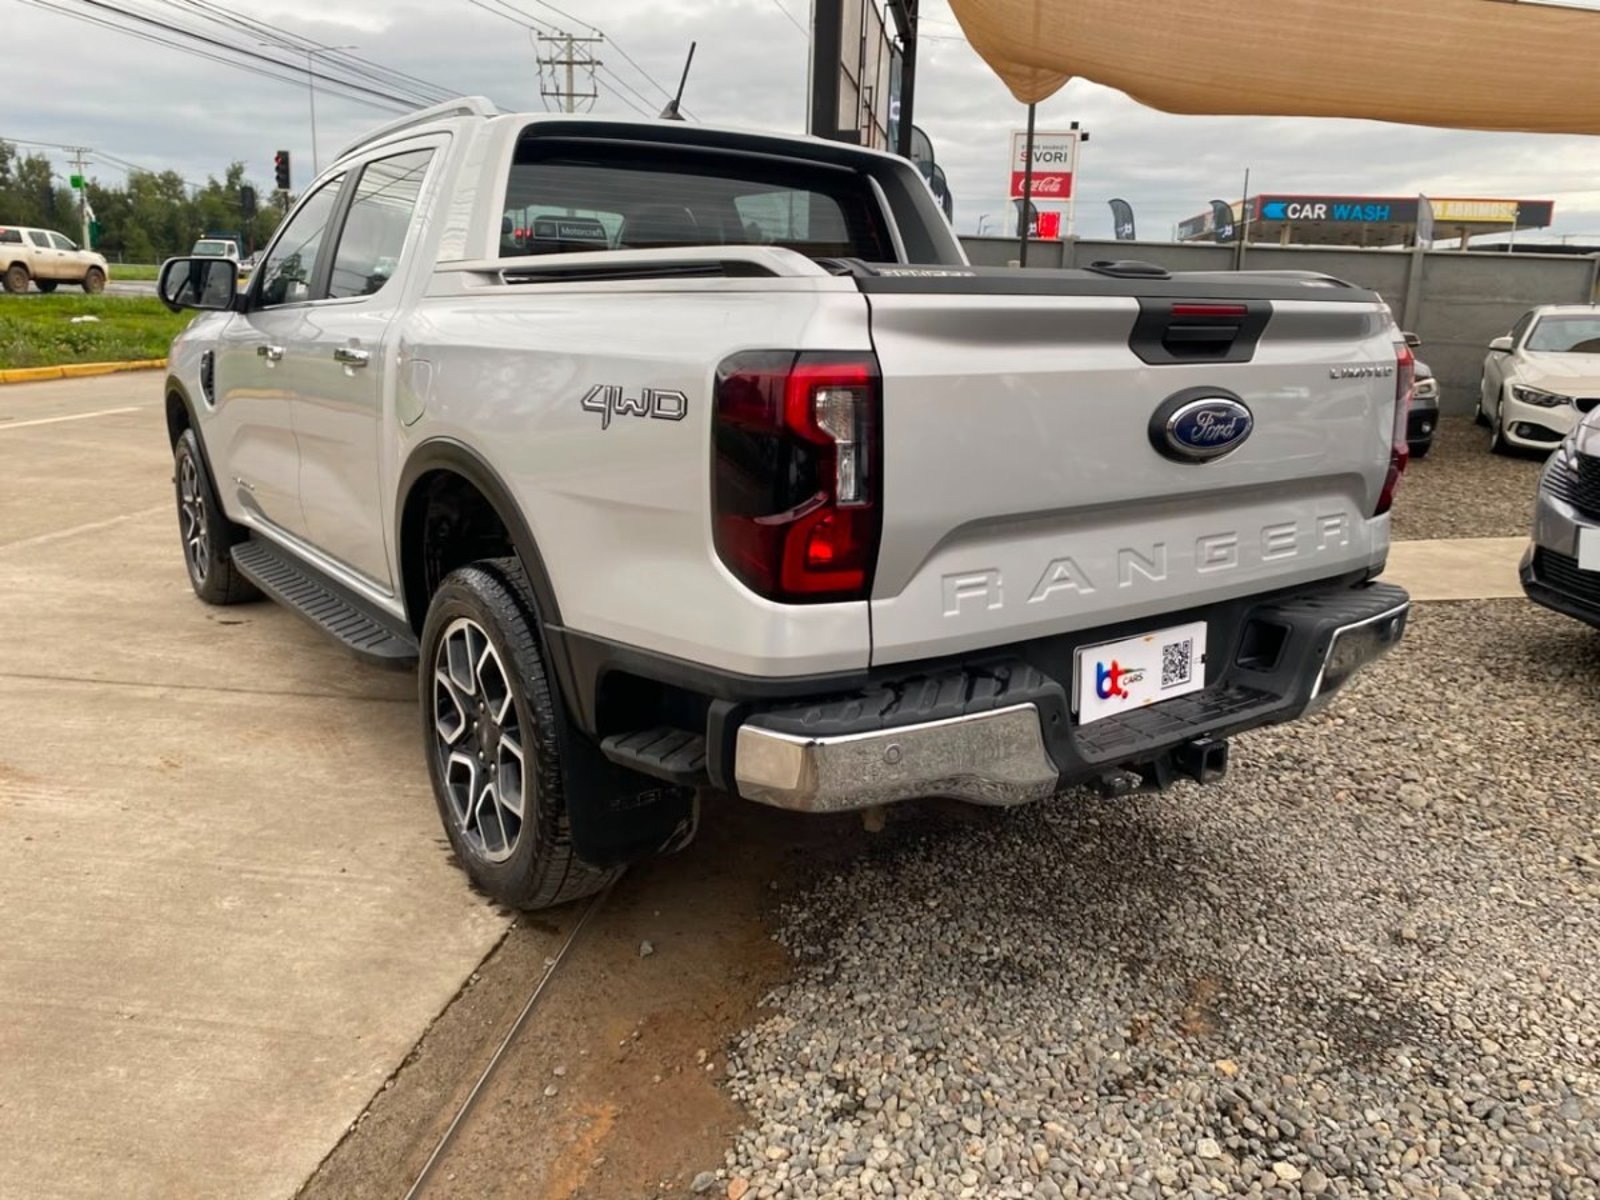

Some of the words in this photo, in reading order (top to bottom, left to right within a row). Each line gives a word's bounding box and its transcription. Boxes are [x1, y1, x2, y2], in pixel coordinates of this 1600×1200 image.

[1019, 151, 1068, 162] SVORI
[1286, 203, 1327, 219] CAR
[1333, 204, 1390, 220] WASH
[561, 226, 604, 237] Motorcraft
[1329, 366, 1393, 379] LIMITED
[580, 384, 688, 430] 4WD
[1190, 410, 1237, 442] Ford
[941, 512, 1350, 617] RANGER
[1122, 673, 1143, 685] CARS
